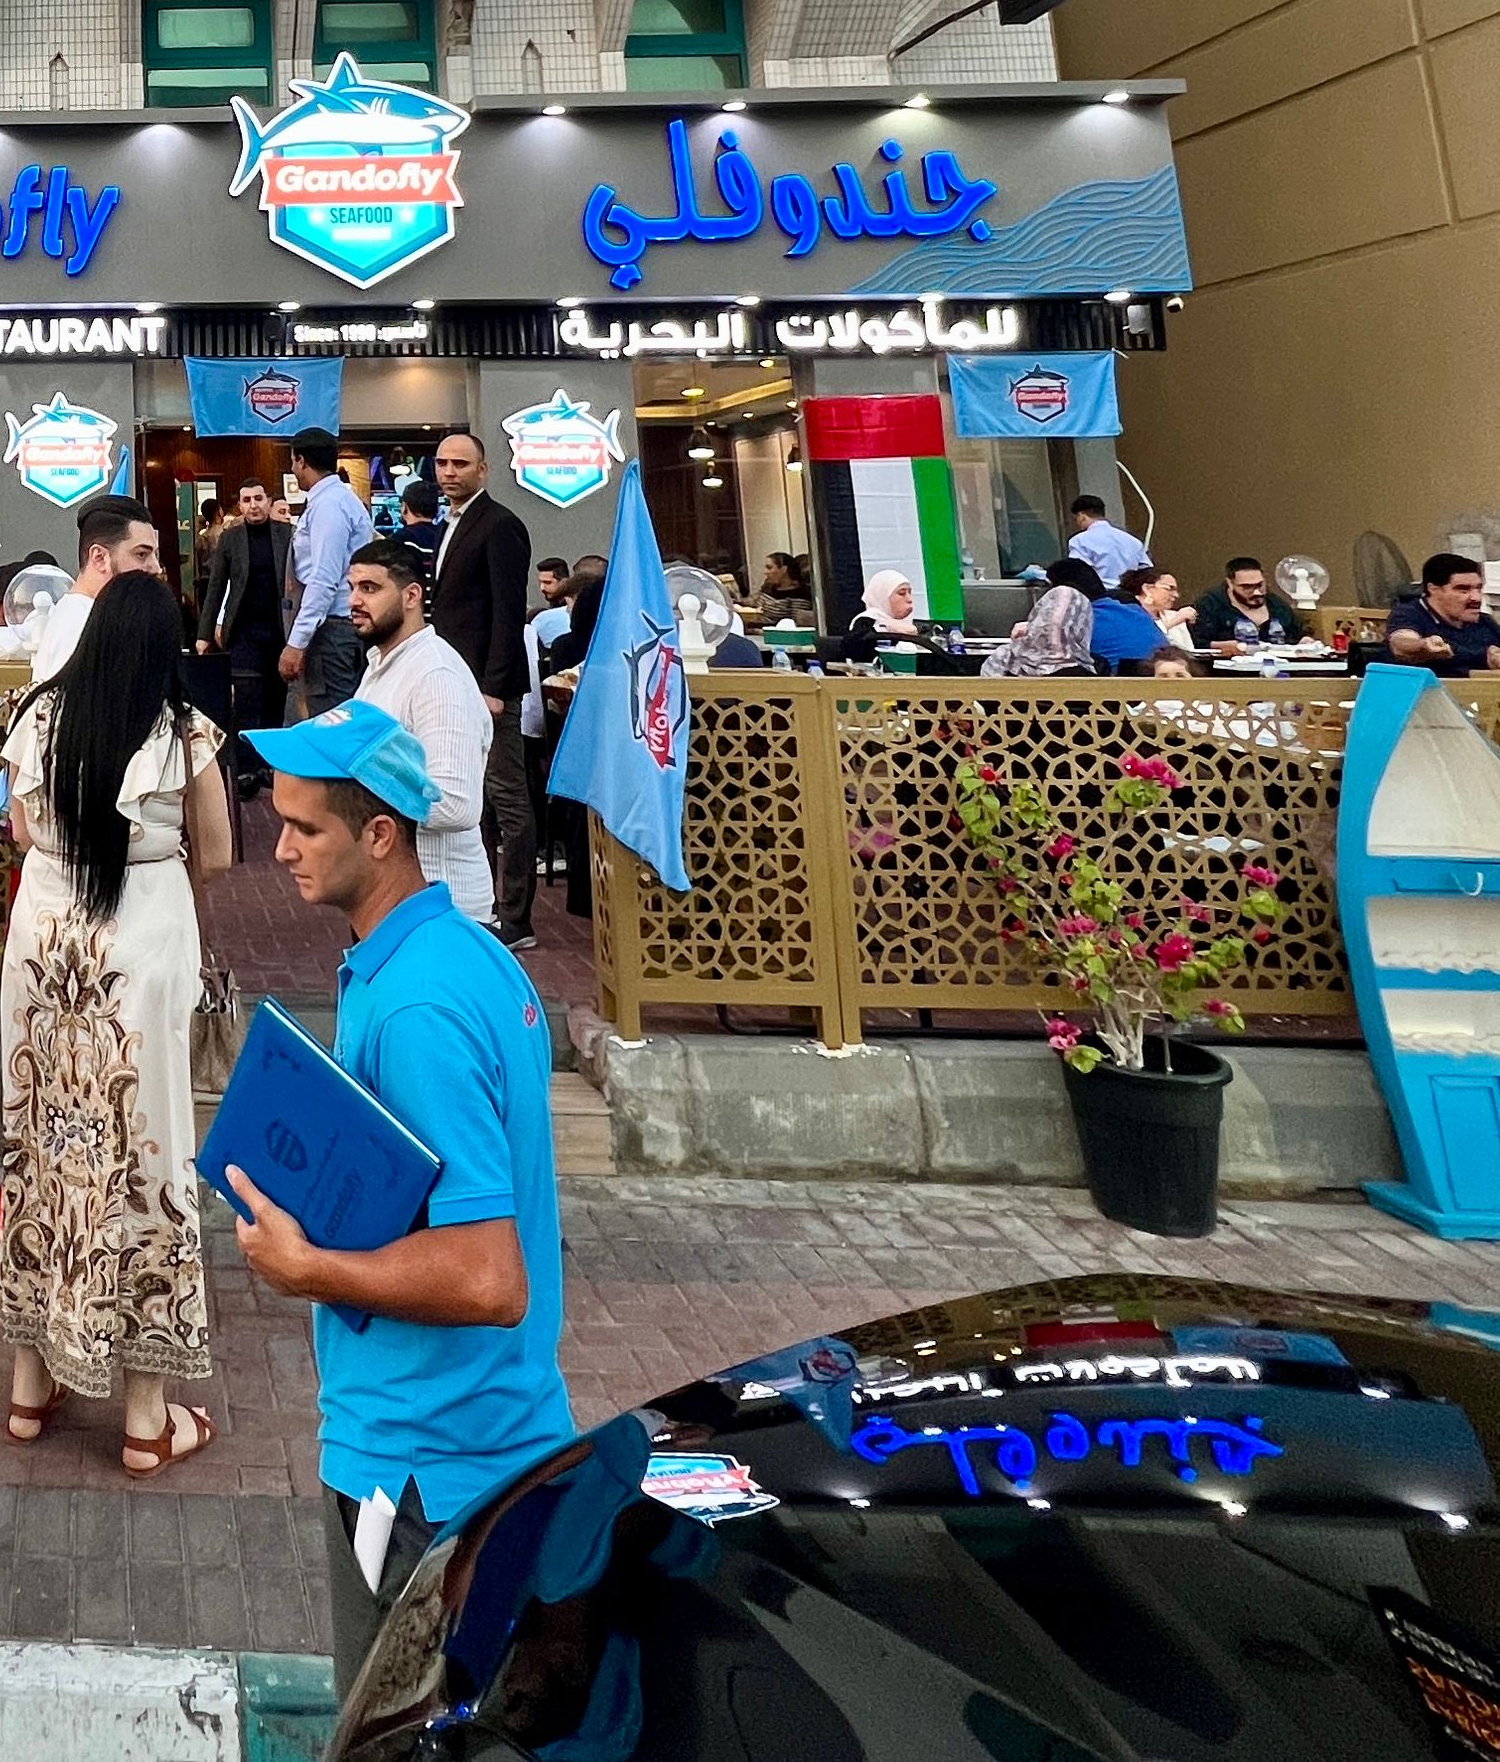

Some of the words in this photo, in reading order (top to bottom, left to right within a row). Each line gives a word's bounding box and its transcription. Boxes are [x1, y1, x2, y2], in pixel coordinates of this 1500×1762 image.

[275, 162, 445, 196] Gandofly
[330, 206, 393, 224] SEAFOOD
[583, 119, 998, 290] جندوفلي
[558, 309, 745, 358] البحرية
[775, 308, 1020, 352] للمأكولات
